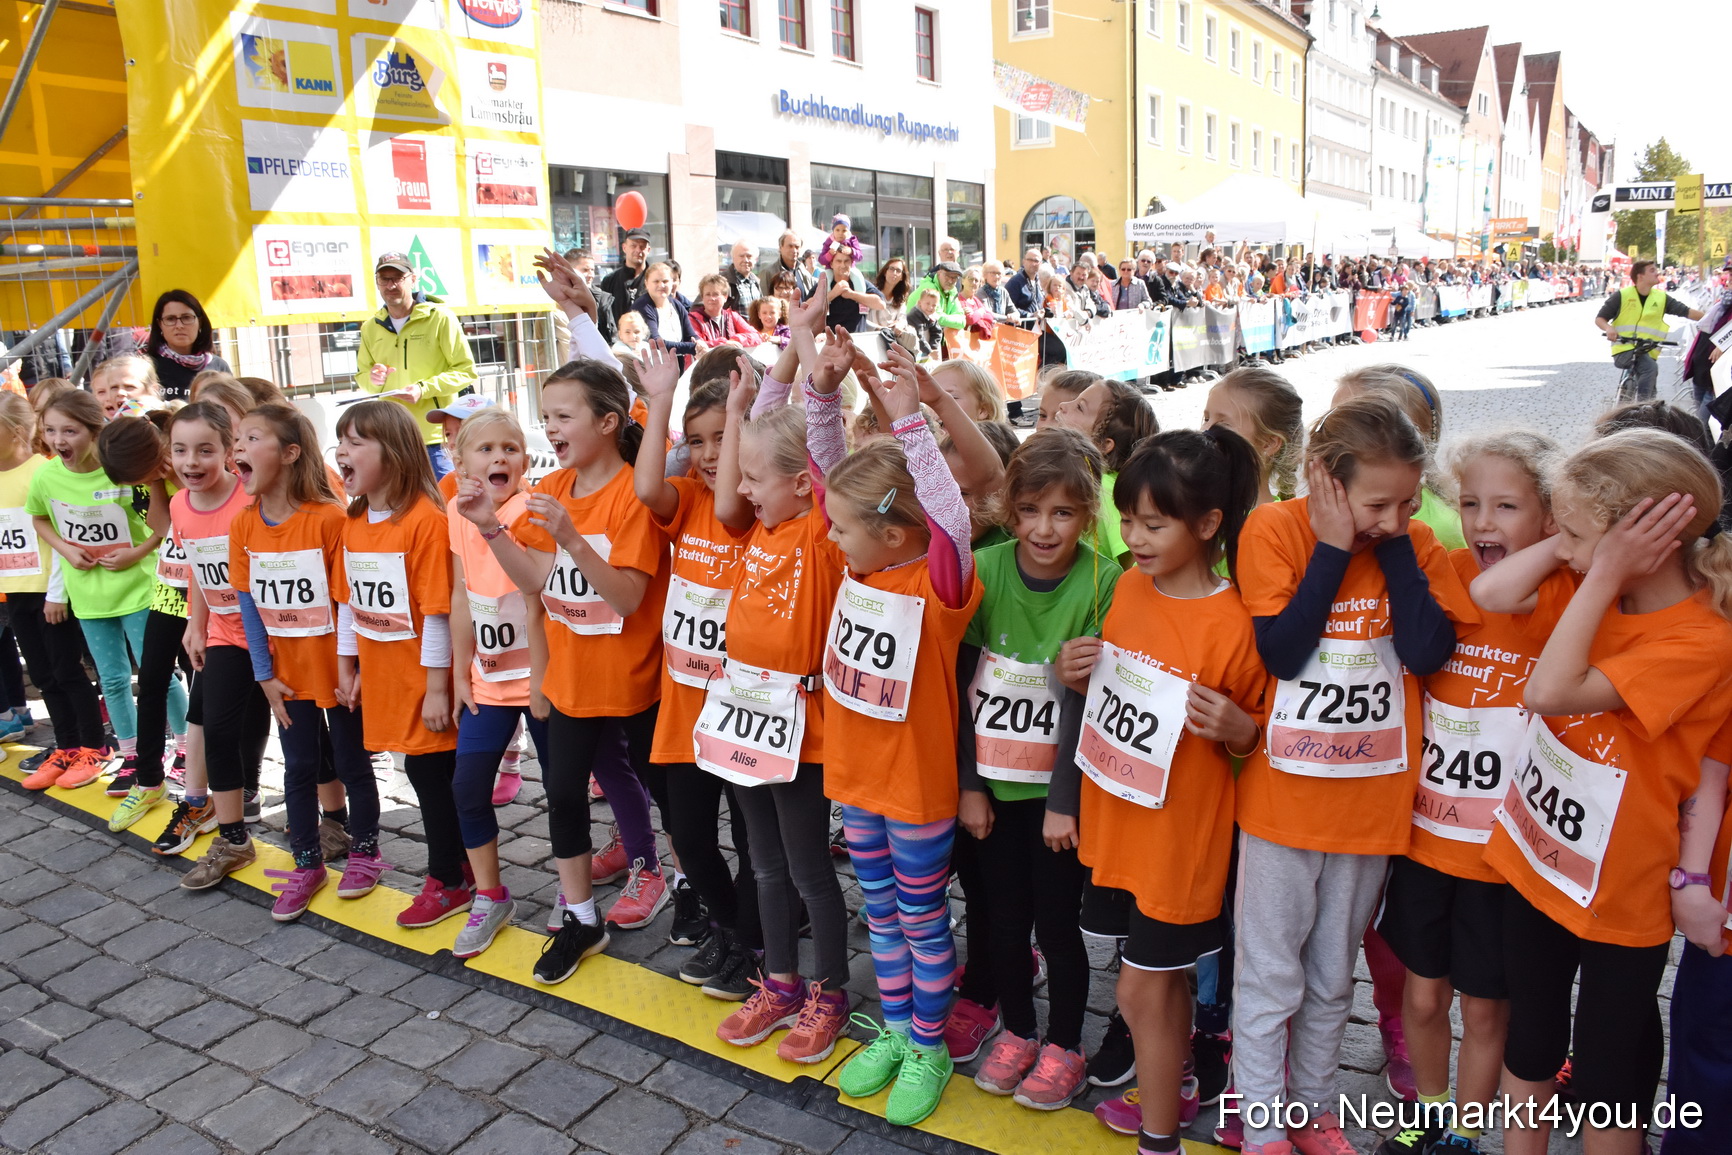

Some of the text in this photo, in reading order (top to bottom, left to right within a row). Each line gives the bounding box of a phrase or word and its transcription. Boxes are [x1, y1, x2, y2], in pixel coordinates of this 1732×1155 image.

[295, 78, 333, 92] KANN
[471, 105, 533, 125] Lammsbräu
[779, 89, 960, 142] Buchhandlung Rupprecht
[264, 158, 349, 178] PFLEIDERER
[394, 177, 428, 197] Braun
[1629, 188, 1667, 200] MINI
[1676, 185, 1701, 194] Jugend
[1683, 192, 1696, 200] lauf
[1154, 222, 1214, 230] ConnectedDrive
[292, 241, 349, 257] Egner
[1510, 247, 1517, 257] A
[1715, 243, 1723, 253] A
[520, 275, 540, 285] KAN
[0, 529, 26, 550] 45
[64, 520, 118, 542] 7230
[267, 560, 296, 568] BOCK
[351, 561, 379, 569] BOCK
[221, 593, 236, 602] Eva
[256, 577, 315, 604] 7178
[692, 594, 726, 606] BOCK
[849, 591, 885, 613] BOCK
[278, 613, 298, 623] Julia
[561, 605, 587, 618] Tessa
[835, 609, 897, 670] 7279
[686, 657, 709, 672] Julia
[1331, 652, 1378, 666] BOCK
[1003, 671, 1047, 687] BOCK
[1119, 666, 1155, 692] BOCK
[735, 687, 771, 702] BOCK
[1296, 680, 1391, 724] 7253
[973, 688, 1056, 736] 7204
[1096, 685, 1159, 755] 7262
[717, 700, 788, 749] 7073
[1435, 713, 1480, 732] BOCK
[1284, 734, 1377, 760] Anouk
[730, 750, 757, 768] Alise
[1089, 735, 1135, 780] Fiona
[1541, 738, 1575, 778] BOCK
[1521, 748, 1585, 842] 7248
